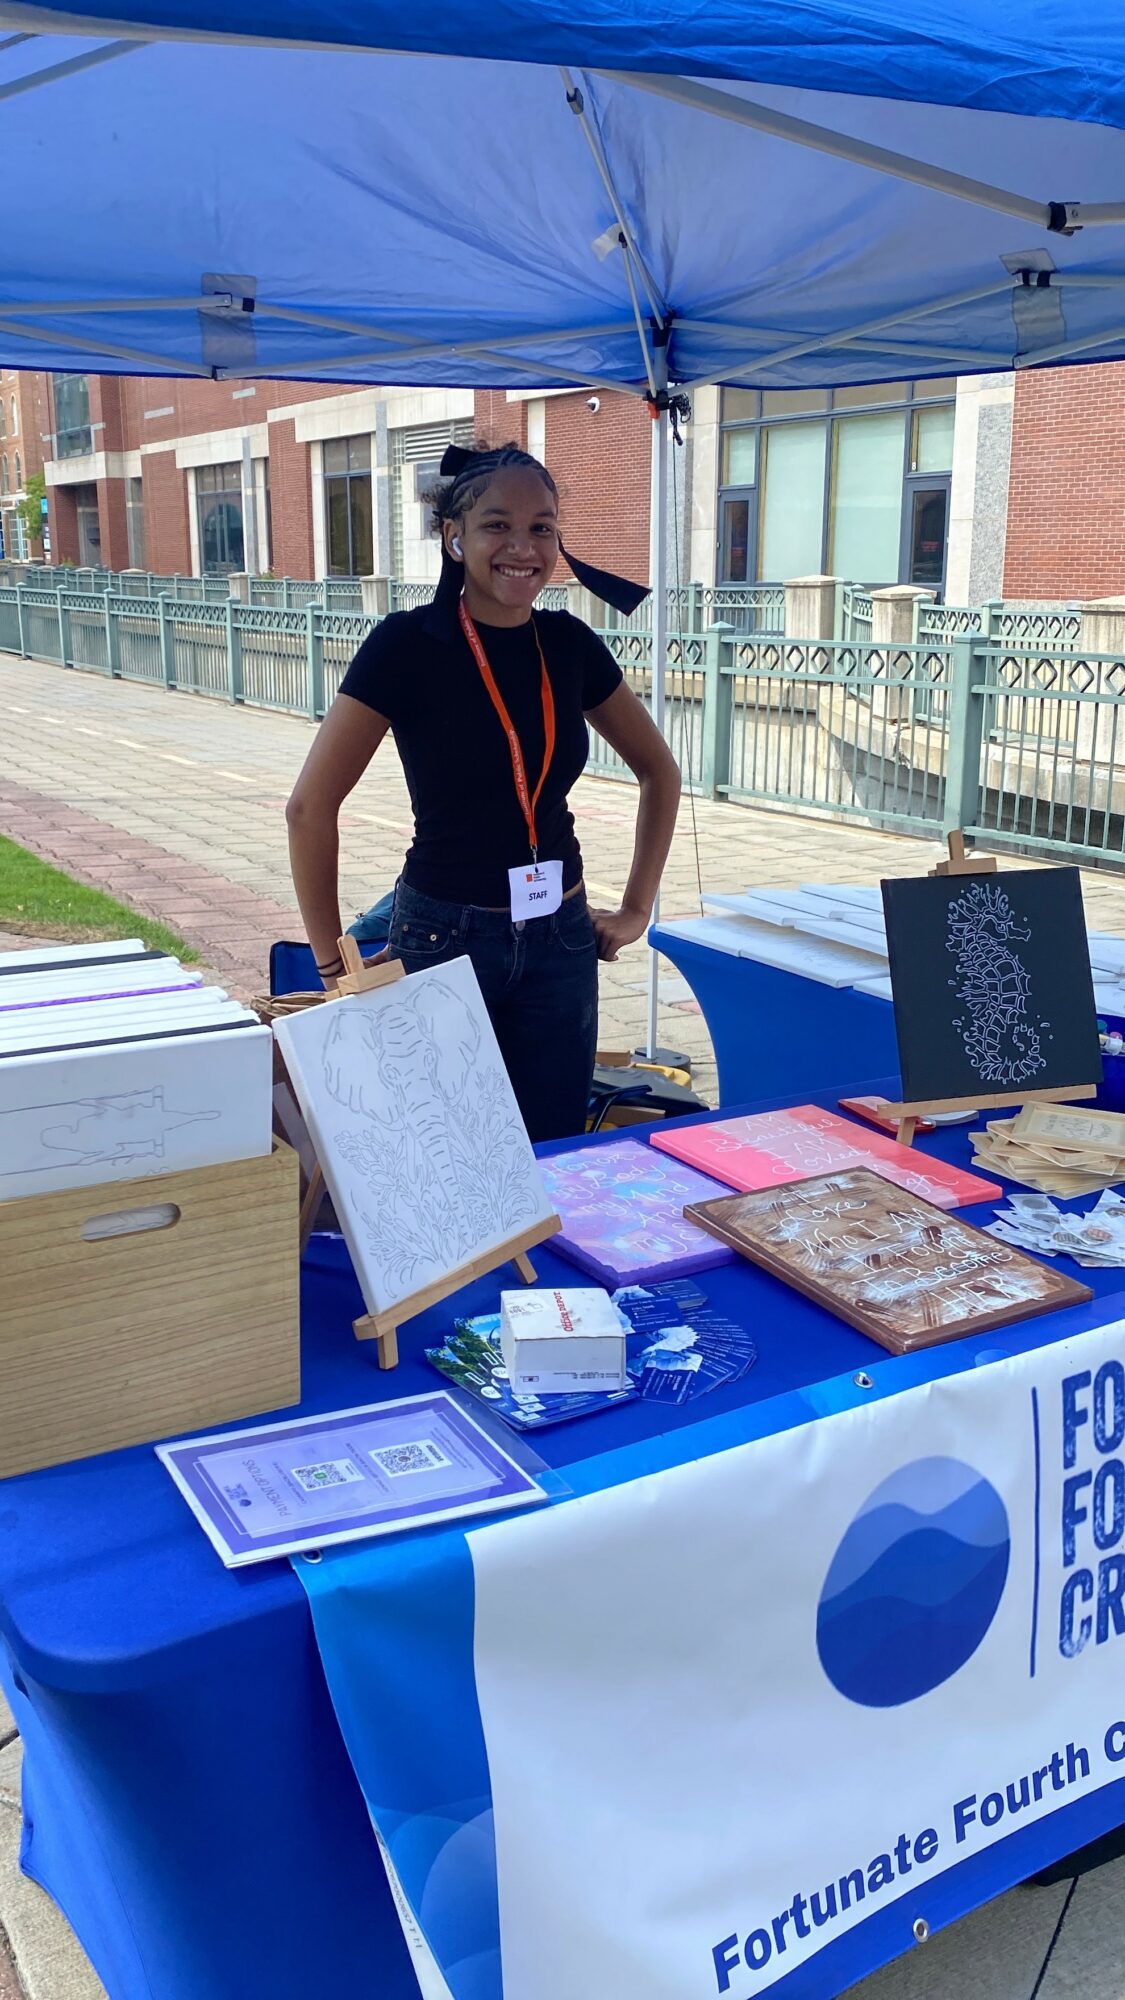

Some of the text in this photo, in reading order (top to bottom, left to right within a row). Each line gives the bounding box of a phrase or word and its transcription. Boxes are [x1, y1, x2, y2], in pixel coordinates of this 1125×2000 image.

[528, 890, 548, 901] STAFF
[706, 1115, 782, 1136] I AM
[756, 1137, 842, 1161] I AM
[772, 1144, 871, 1175] Loved
[580, 1199, 628, 1217] my
[782, 1190, 821, 1206] I
[767, 1200, 867, 1233] Love
[788, 1207, 947, 1256] Who I AM
[898, 1251, 1013, 1287] Become
[553, 1291, 567, 1311] DEPOT
[242, 1459, 270, 1487] OPTIONS
[261, 1487, 293, 1517] PAYMENT
[711, 1827, 939, 1993] Fortunate
[952, 1742, 1091, 1844] Fourth
